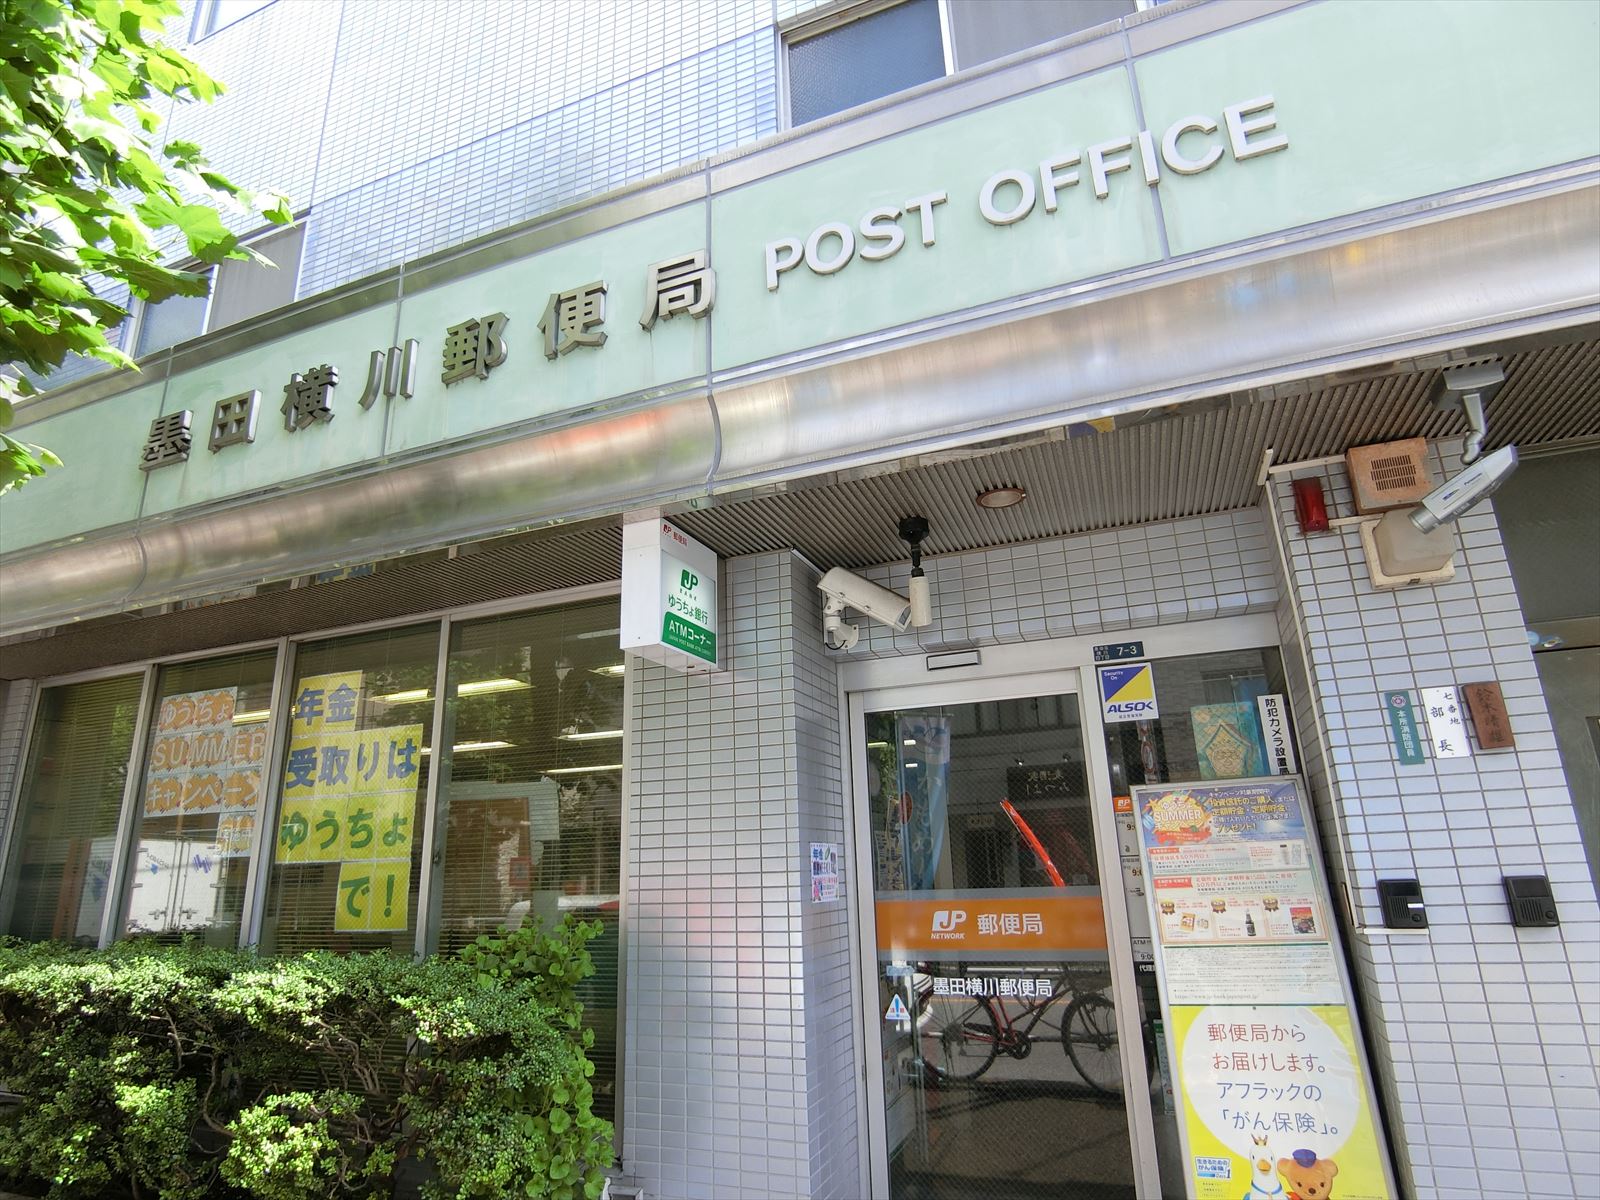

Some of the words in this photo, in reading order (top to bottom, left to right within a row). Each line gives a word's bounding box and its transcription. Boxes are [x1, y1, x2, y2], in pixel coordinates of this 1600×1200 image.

[765, 192, 948, 293] POST
[979, 95, 1289, 227] OFFICE
[138, 249, 716, 472] 墨田横川郵便局
[681, 569, 698, 591] JP
[668, 593, 708, 625] ゆうちょ銀行
[669, 619, 711, 645] ATMコーナー
[1116, 645, 1137, 656] 7-3
[164, 699, 229, 728] ゆうちょ
[295, 683, 358, 726] 年金
[1107, 701, 1153, 714] ALSOK
[153, 732, 265, 767] SUMMER
[286, 738, 418, 789] 受取りは
[1154, 809, 1201, 821] SUMMER
[281, 808, 409, 850] ゆうちょ
[932, 910, 966, 931] JP
[977, 913, 1043, 935] 郵便局
[933, 977, 1052, 997] 墨田横川郵便局
[1207, 1023, 1306, 1043] 郵便局から
[1212, 1052, 1326, 1073] お届けします。
[1216, 1082, 1322, 1102] アフラックの
[1222, 1109, 1338, 1135] 「がん保険」。
